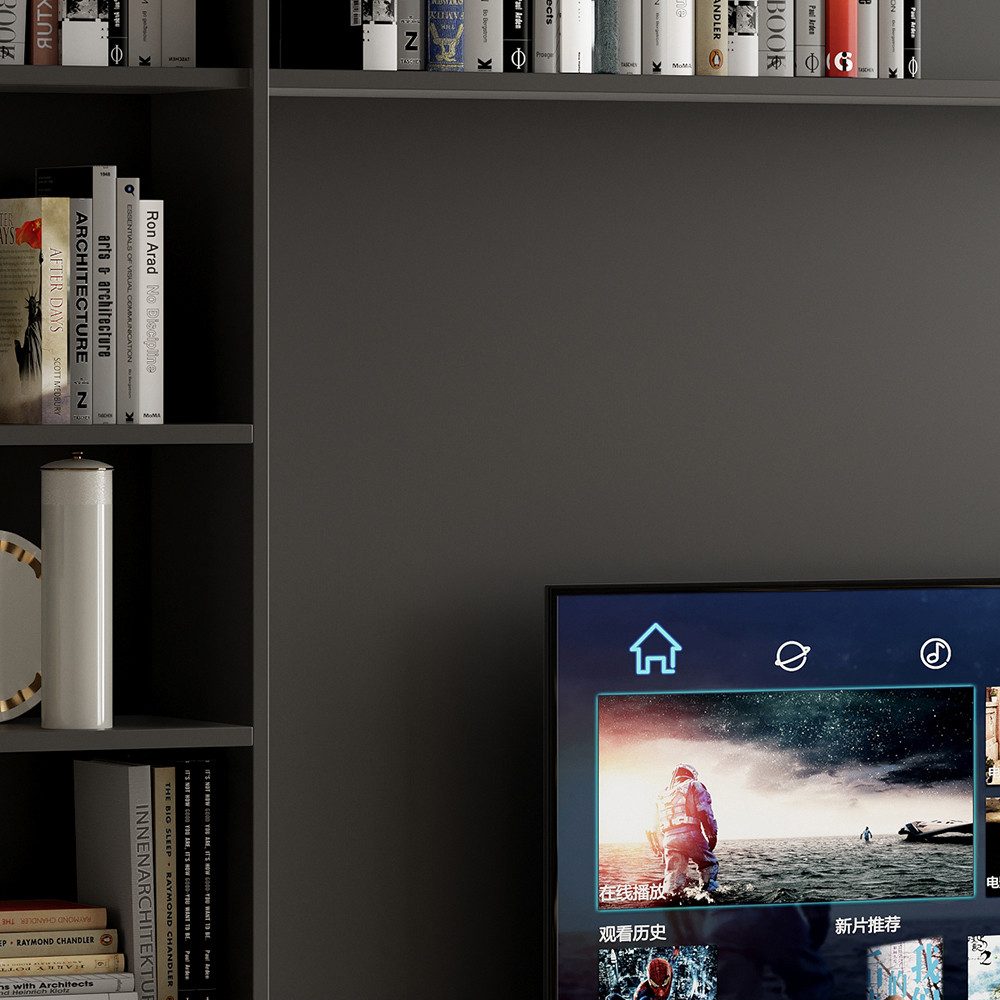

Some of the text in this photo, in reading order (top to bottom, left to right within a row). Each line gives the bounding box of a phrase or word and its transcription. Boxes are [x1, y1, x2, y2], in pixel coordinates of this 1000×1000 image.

[98, 235, 112, 260] arts
[126, 252, 132, 262] OF
[50, 248, 63, 333] AFTER DAYS
[76, 212, 88, 363] ARCHITECTURE
[143, 211, 159, 373] Ron Arad No Discipline
[98, 282, 113, 357] architecture
[598, 882, 667, 901] 在线播放
[598, 923, 667, 943] 观看历史
[834, 915, 901, 935] 新片推荐
[17, 936, 95, 946] RAYMOND CHANDLER
[980, 950, 991, 965] 2
[39, 980, 94, 988] Architects
